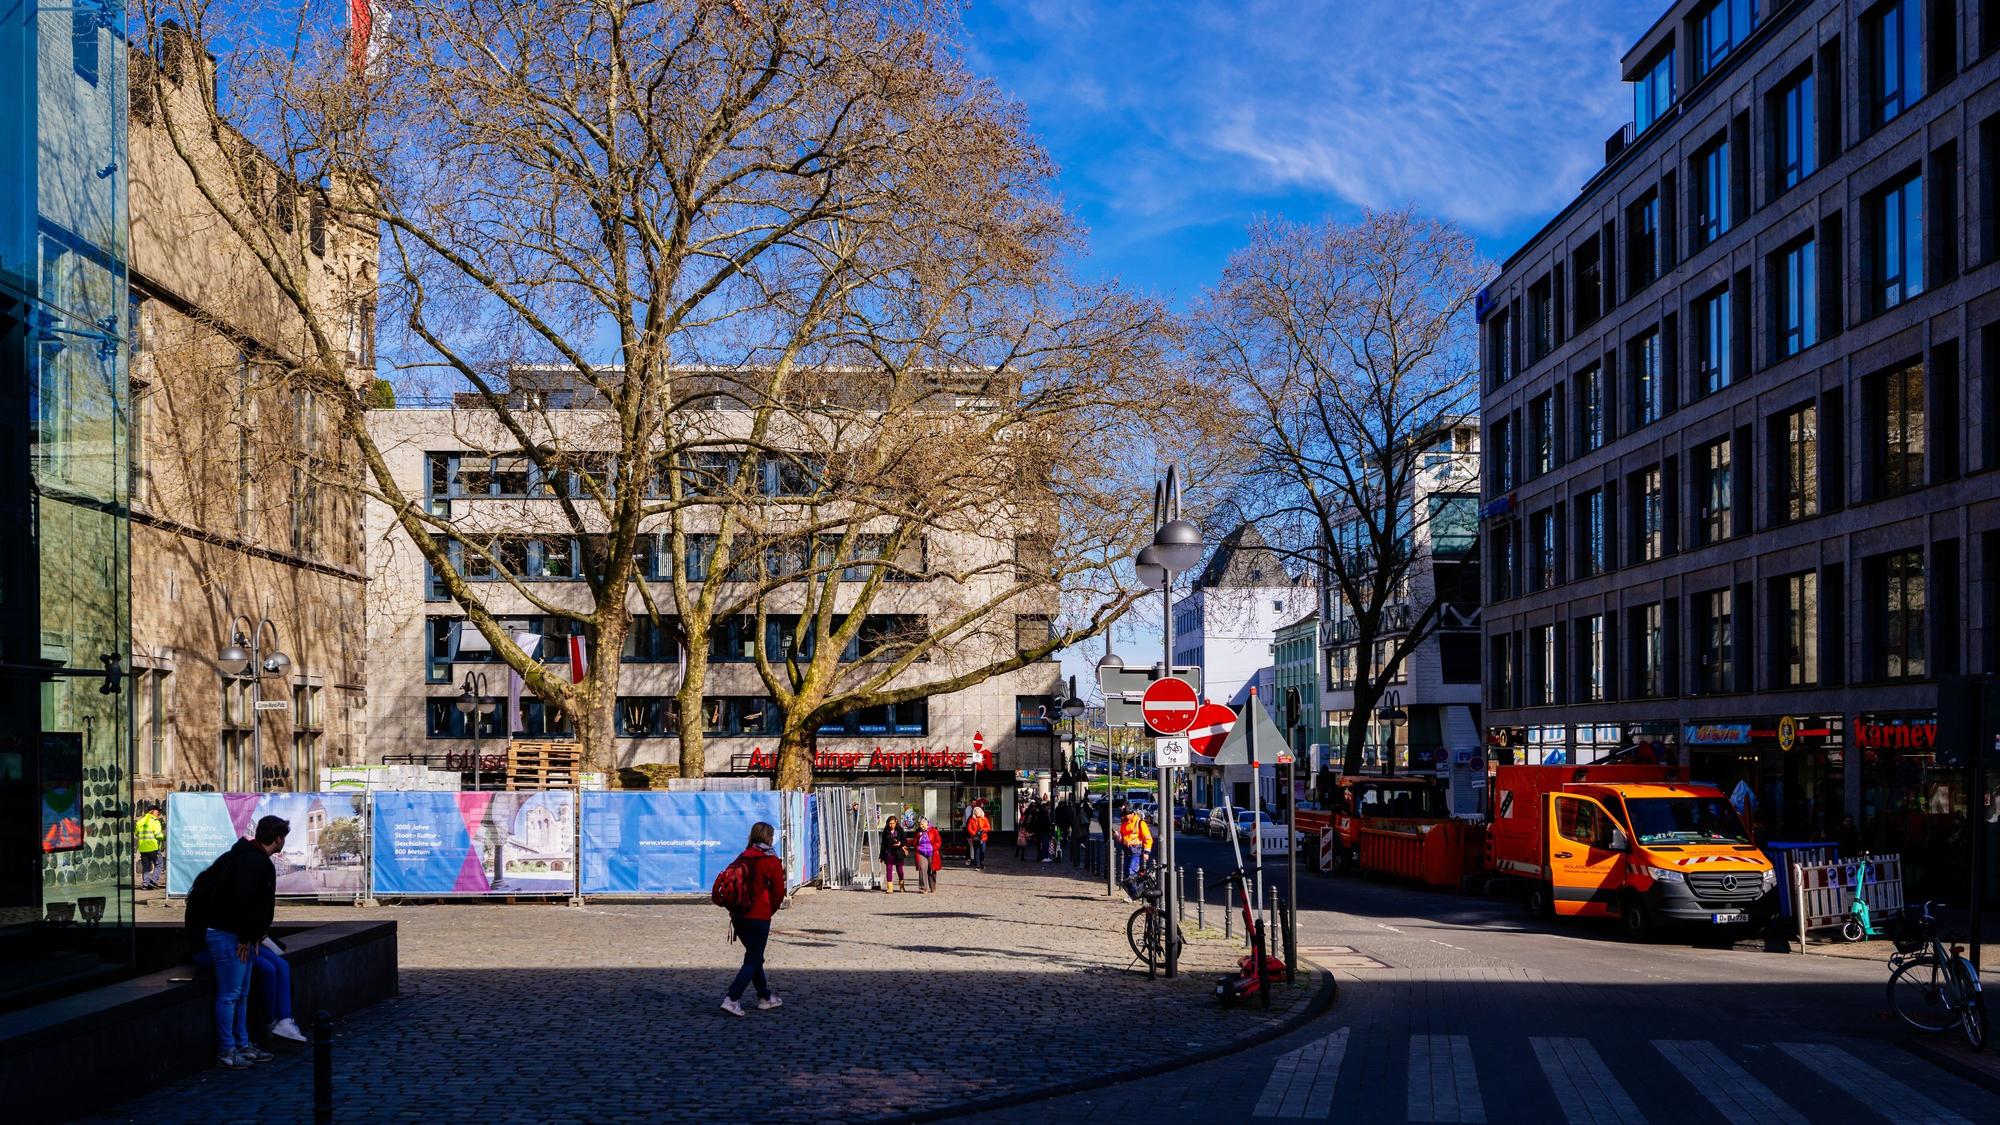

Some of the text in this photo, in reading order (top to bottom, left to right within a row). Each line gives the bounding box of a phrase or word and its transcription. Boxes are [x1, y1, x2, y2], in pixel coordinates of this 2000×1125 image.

[750, 746, 968, 771] Autiner Apotheke
[639, 839, 722, 847] www.viaculturalis.cologne
